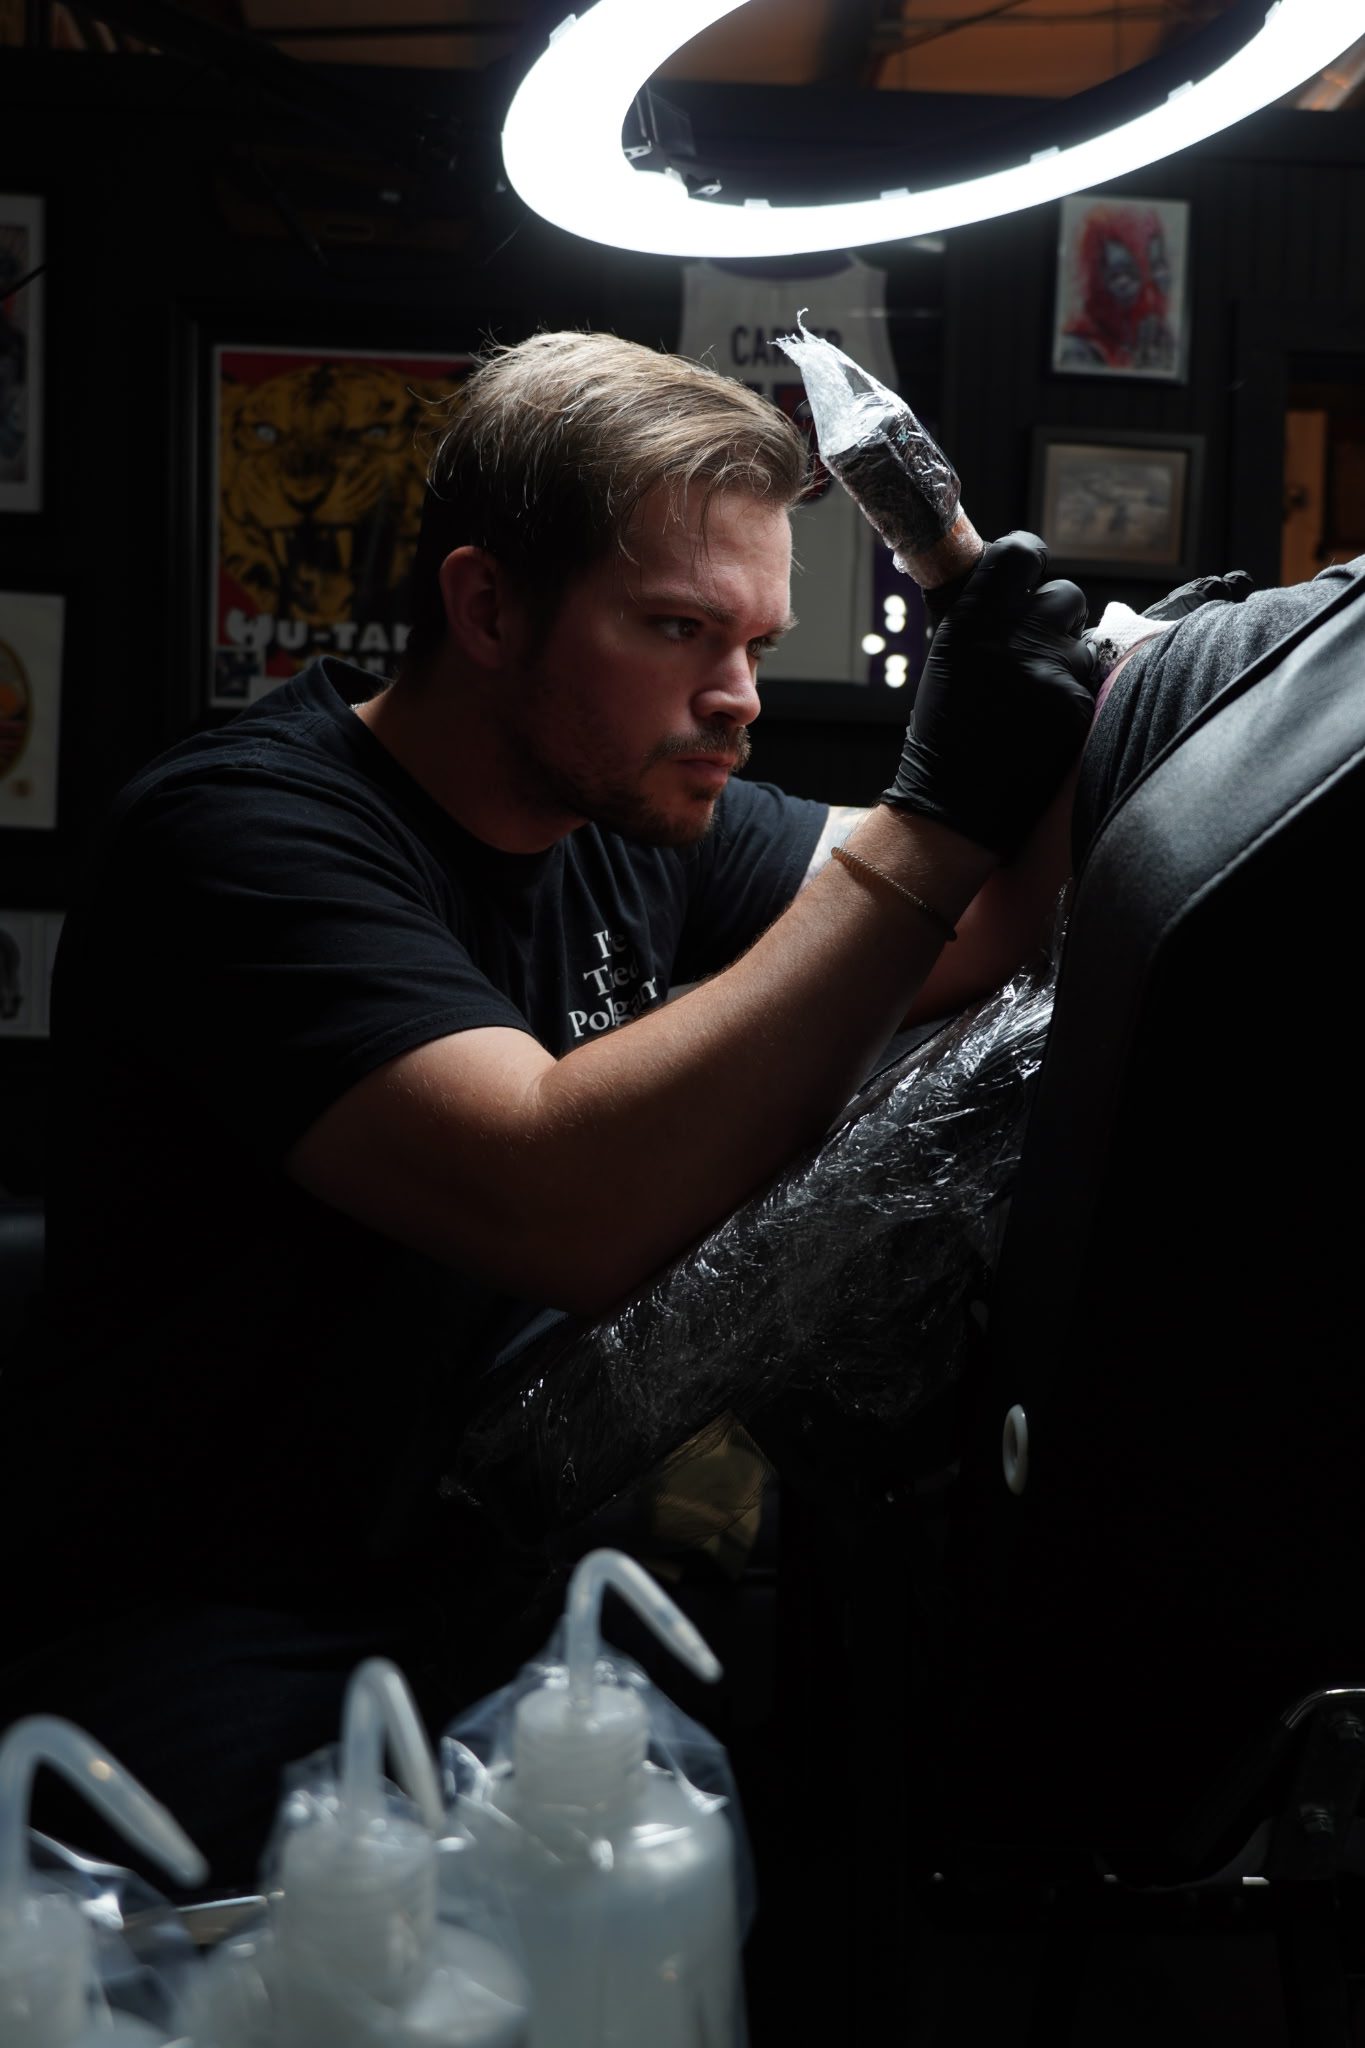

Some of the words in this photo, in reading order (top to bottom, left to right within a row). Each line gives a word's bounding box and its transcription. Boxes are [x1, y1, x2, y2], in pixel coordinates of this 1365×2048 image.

[730, 325, 842, 367] CAR
[592, 929, 628, 960] I'e
[582, 947, 640, 997] Ted
